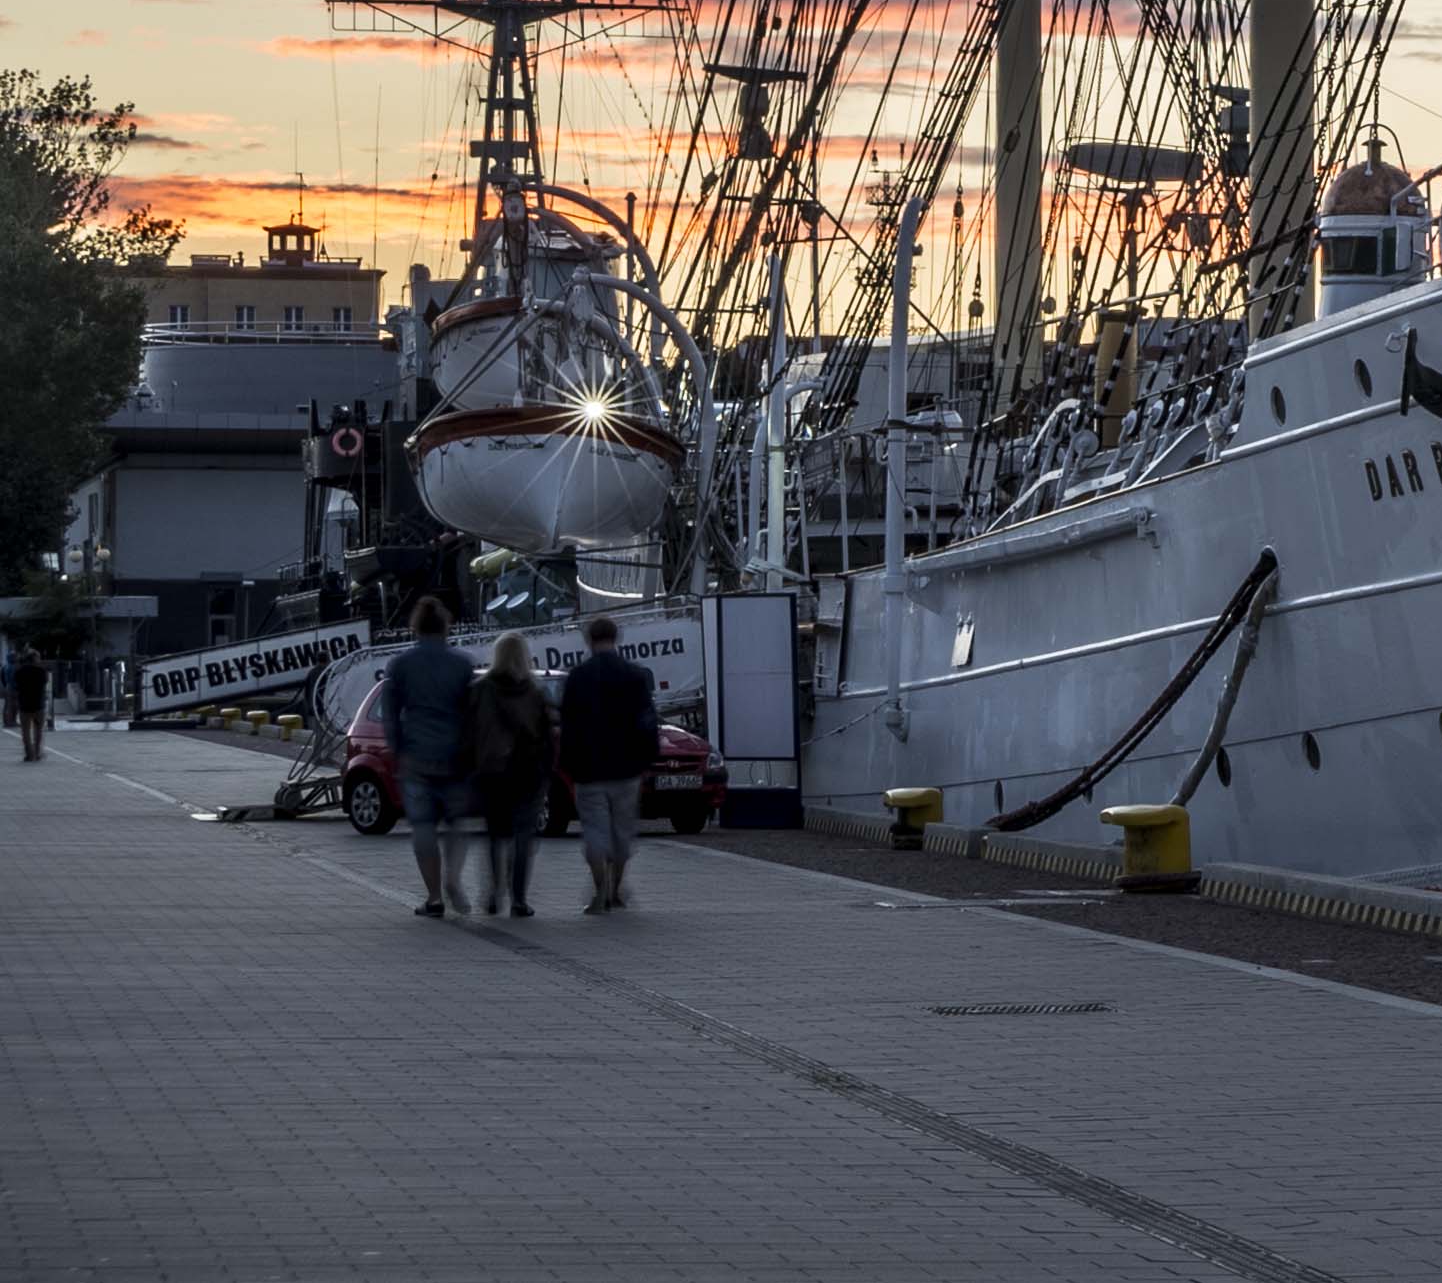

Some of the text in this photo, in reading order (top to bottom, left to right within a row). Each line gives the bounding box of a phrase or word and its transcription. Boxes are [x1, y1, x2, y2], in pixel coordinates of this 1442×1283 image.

[1364, 449, 1423, 501] DAR
[152, 633, 362, 698] ORP BŁYSKAWICA
[545, 646, 585, 670] Dar
